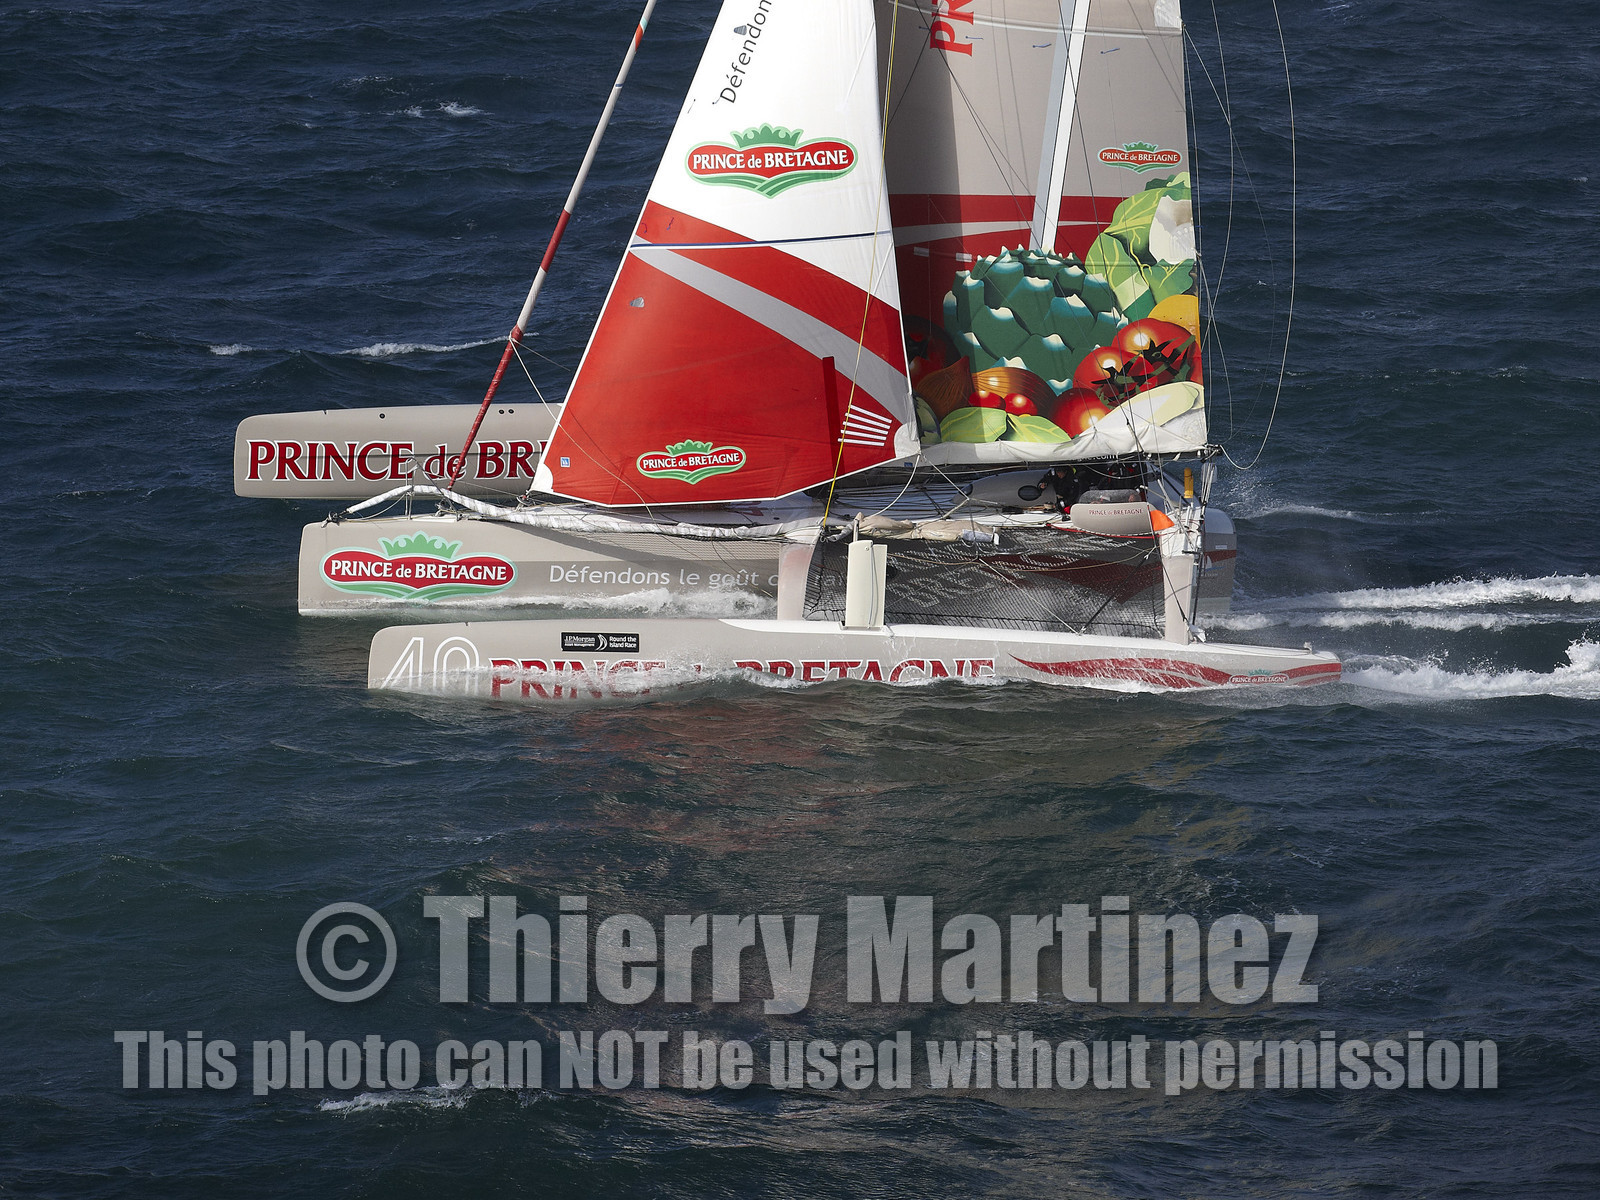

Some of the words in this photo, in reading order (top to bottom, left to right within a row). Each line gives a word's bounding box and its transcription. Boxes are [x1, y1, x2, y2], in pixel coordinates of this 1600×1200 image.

[692, 153, 745, 170] PRINCE
[747, 154, 762, 169] de
[764, 149, 849, 169] BRETAGNE
[1102, 152, 1129, 160] PRINCE
[1138, 153, 1178, 162] BRETAGNE
[245, 439, 415, 481] PRINCE
[415, 444, 467, 480] de
[642, 457, 677, 469] PRINCE
[678, 457, 688, 467] de
[688, 452, 741, 467] BRETAGNE
[330, 559, 393, 576] PRINCE
[395, 563, 412, 578] de
[414, 564, 507, 581] BRETAGNE
[550, 564, 670, 585] Défendons
[680, 568, 700, 585] le
[709, 569, 759, 589] goût
